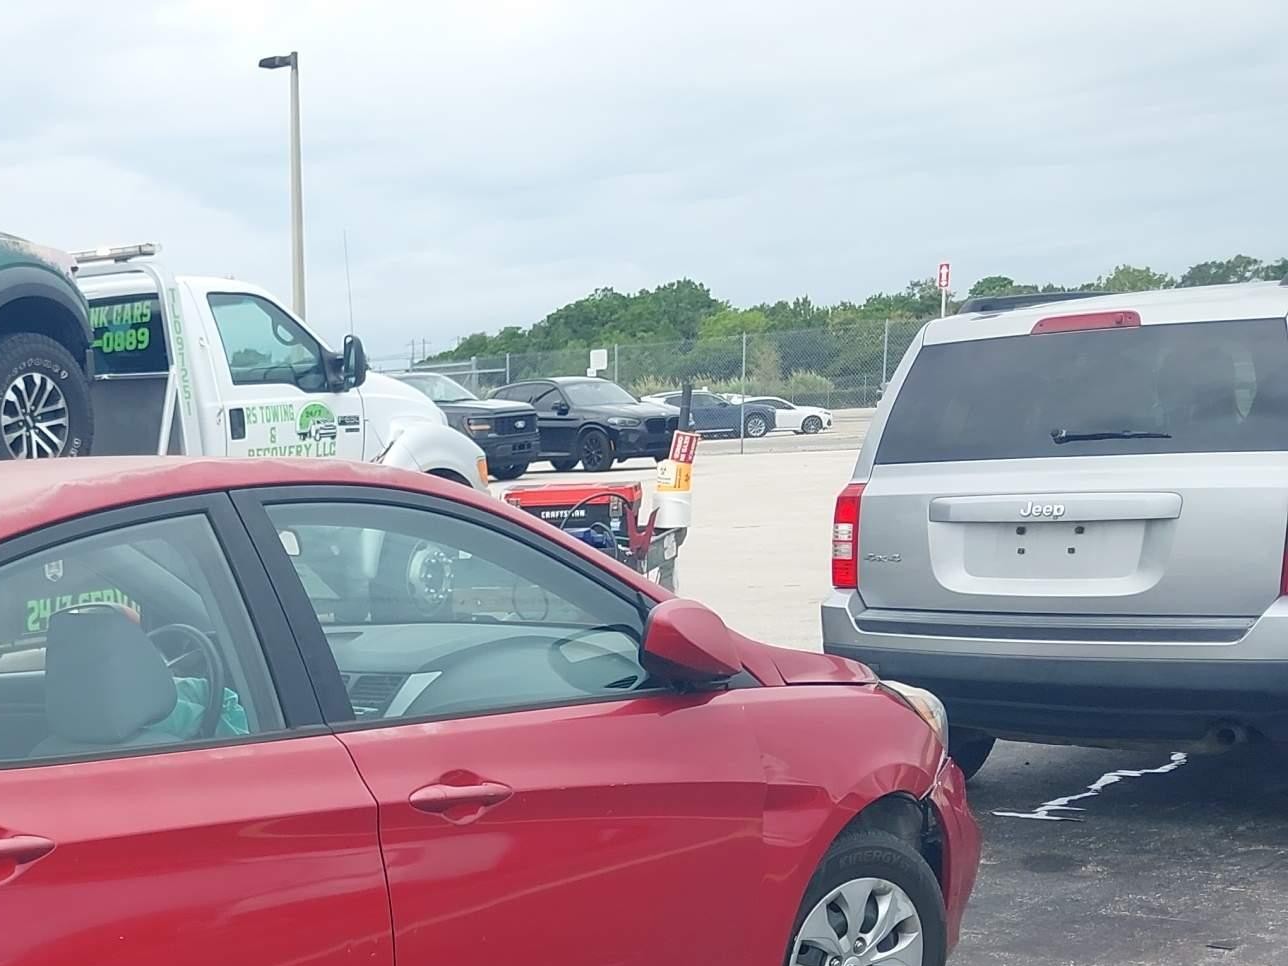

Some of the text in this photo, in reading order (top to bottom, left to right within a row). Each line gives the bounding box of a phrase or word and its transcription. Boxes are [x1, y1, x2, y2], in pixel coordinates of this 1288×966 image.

[113, 301, 151, 325] CARS
[246, 404, 295, 424] RS TOWING
[270, 426, 277, 443] &
[316, 441, 336, 457] LLC
[1019, 501, 1066, 519] Jeep
